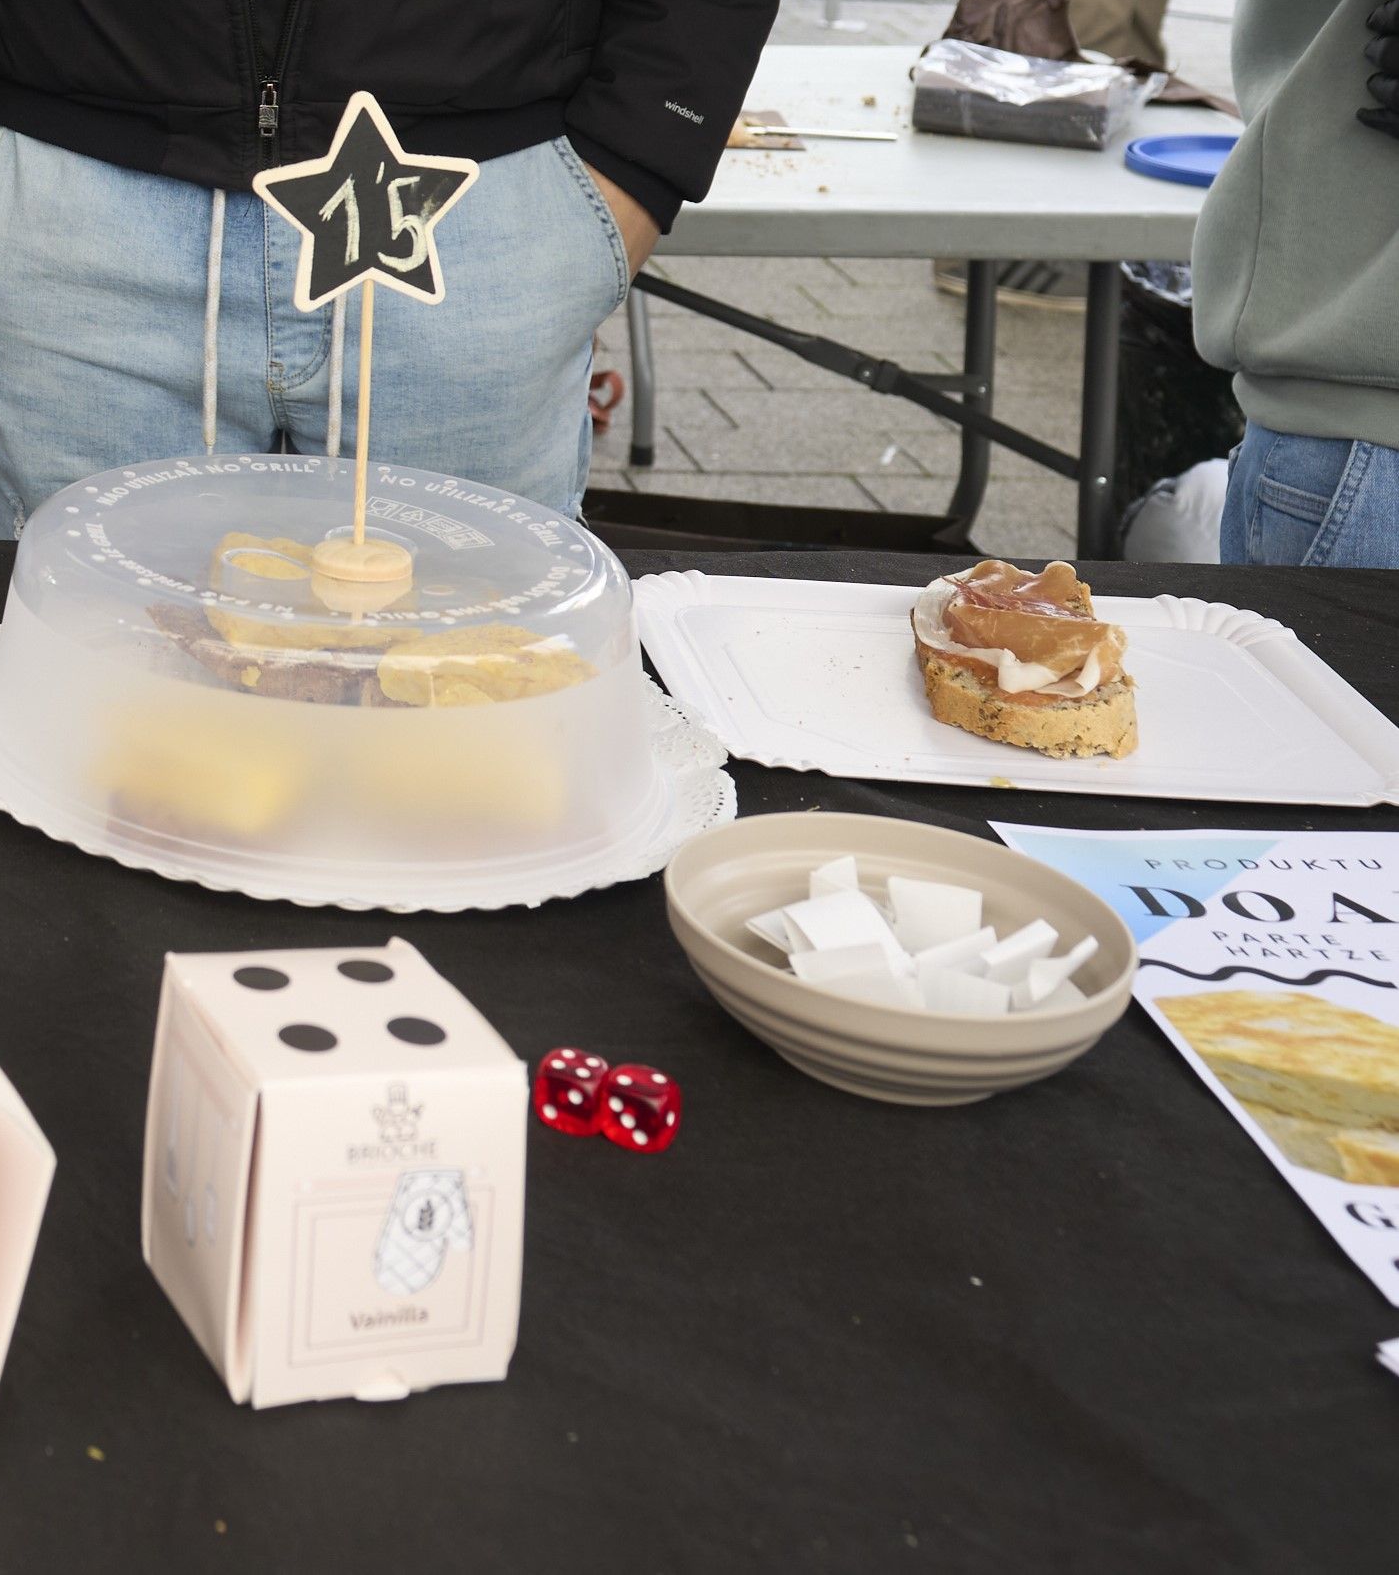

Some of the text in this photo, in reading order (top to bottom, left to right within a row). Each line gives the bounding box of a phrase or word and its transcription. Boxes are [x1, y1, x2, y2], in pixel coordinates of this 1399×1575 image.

[664, 100, 705, 126] windshell
[124, 466, 204, 491] UTILIZAR
[205, 463, 242, 475] NO
[250, 461, 315, 474] GRILL
[380, 474, 564, 548] NO UTILIZAR EL GRILL
[1143, 857, 1383, 871] PRODUKTU
[1118, 883, 1399, 924] DOA
[1211, 930, 1343, 946] PARTE
[1225, 945, 1393, 962] HARTZE
[349, 1305, 430, 1332] Vainilla
